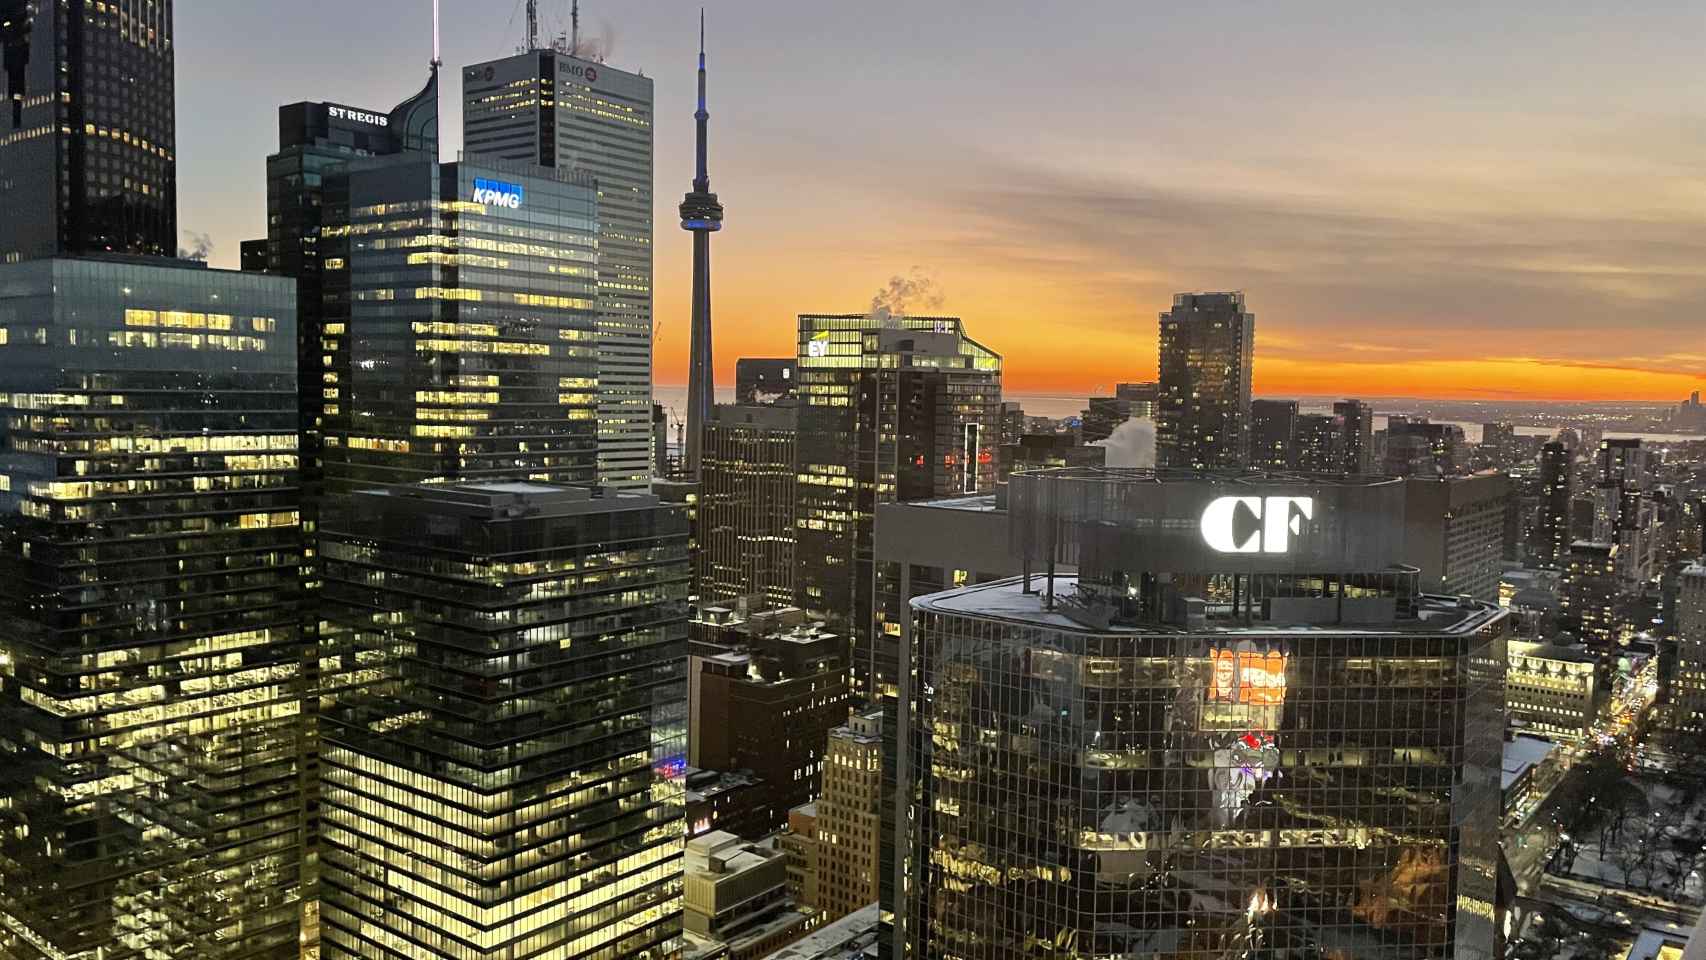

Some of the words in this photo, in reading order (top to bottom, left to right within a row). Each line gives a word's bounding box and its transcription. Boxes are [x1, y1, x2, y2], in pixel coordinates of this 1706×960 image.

[347, 110, 388, 126] REGIS
[473, 187, 520, 208] KPMG
[809, 341, 828, 356] EY
[1201, 496, 1312, 552] CF
